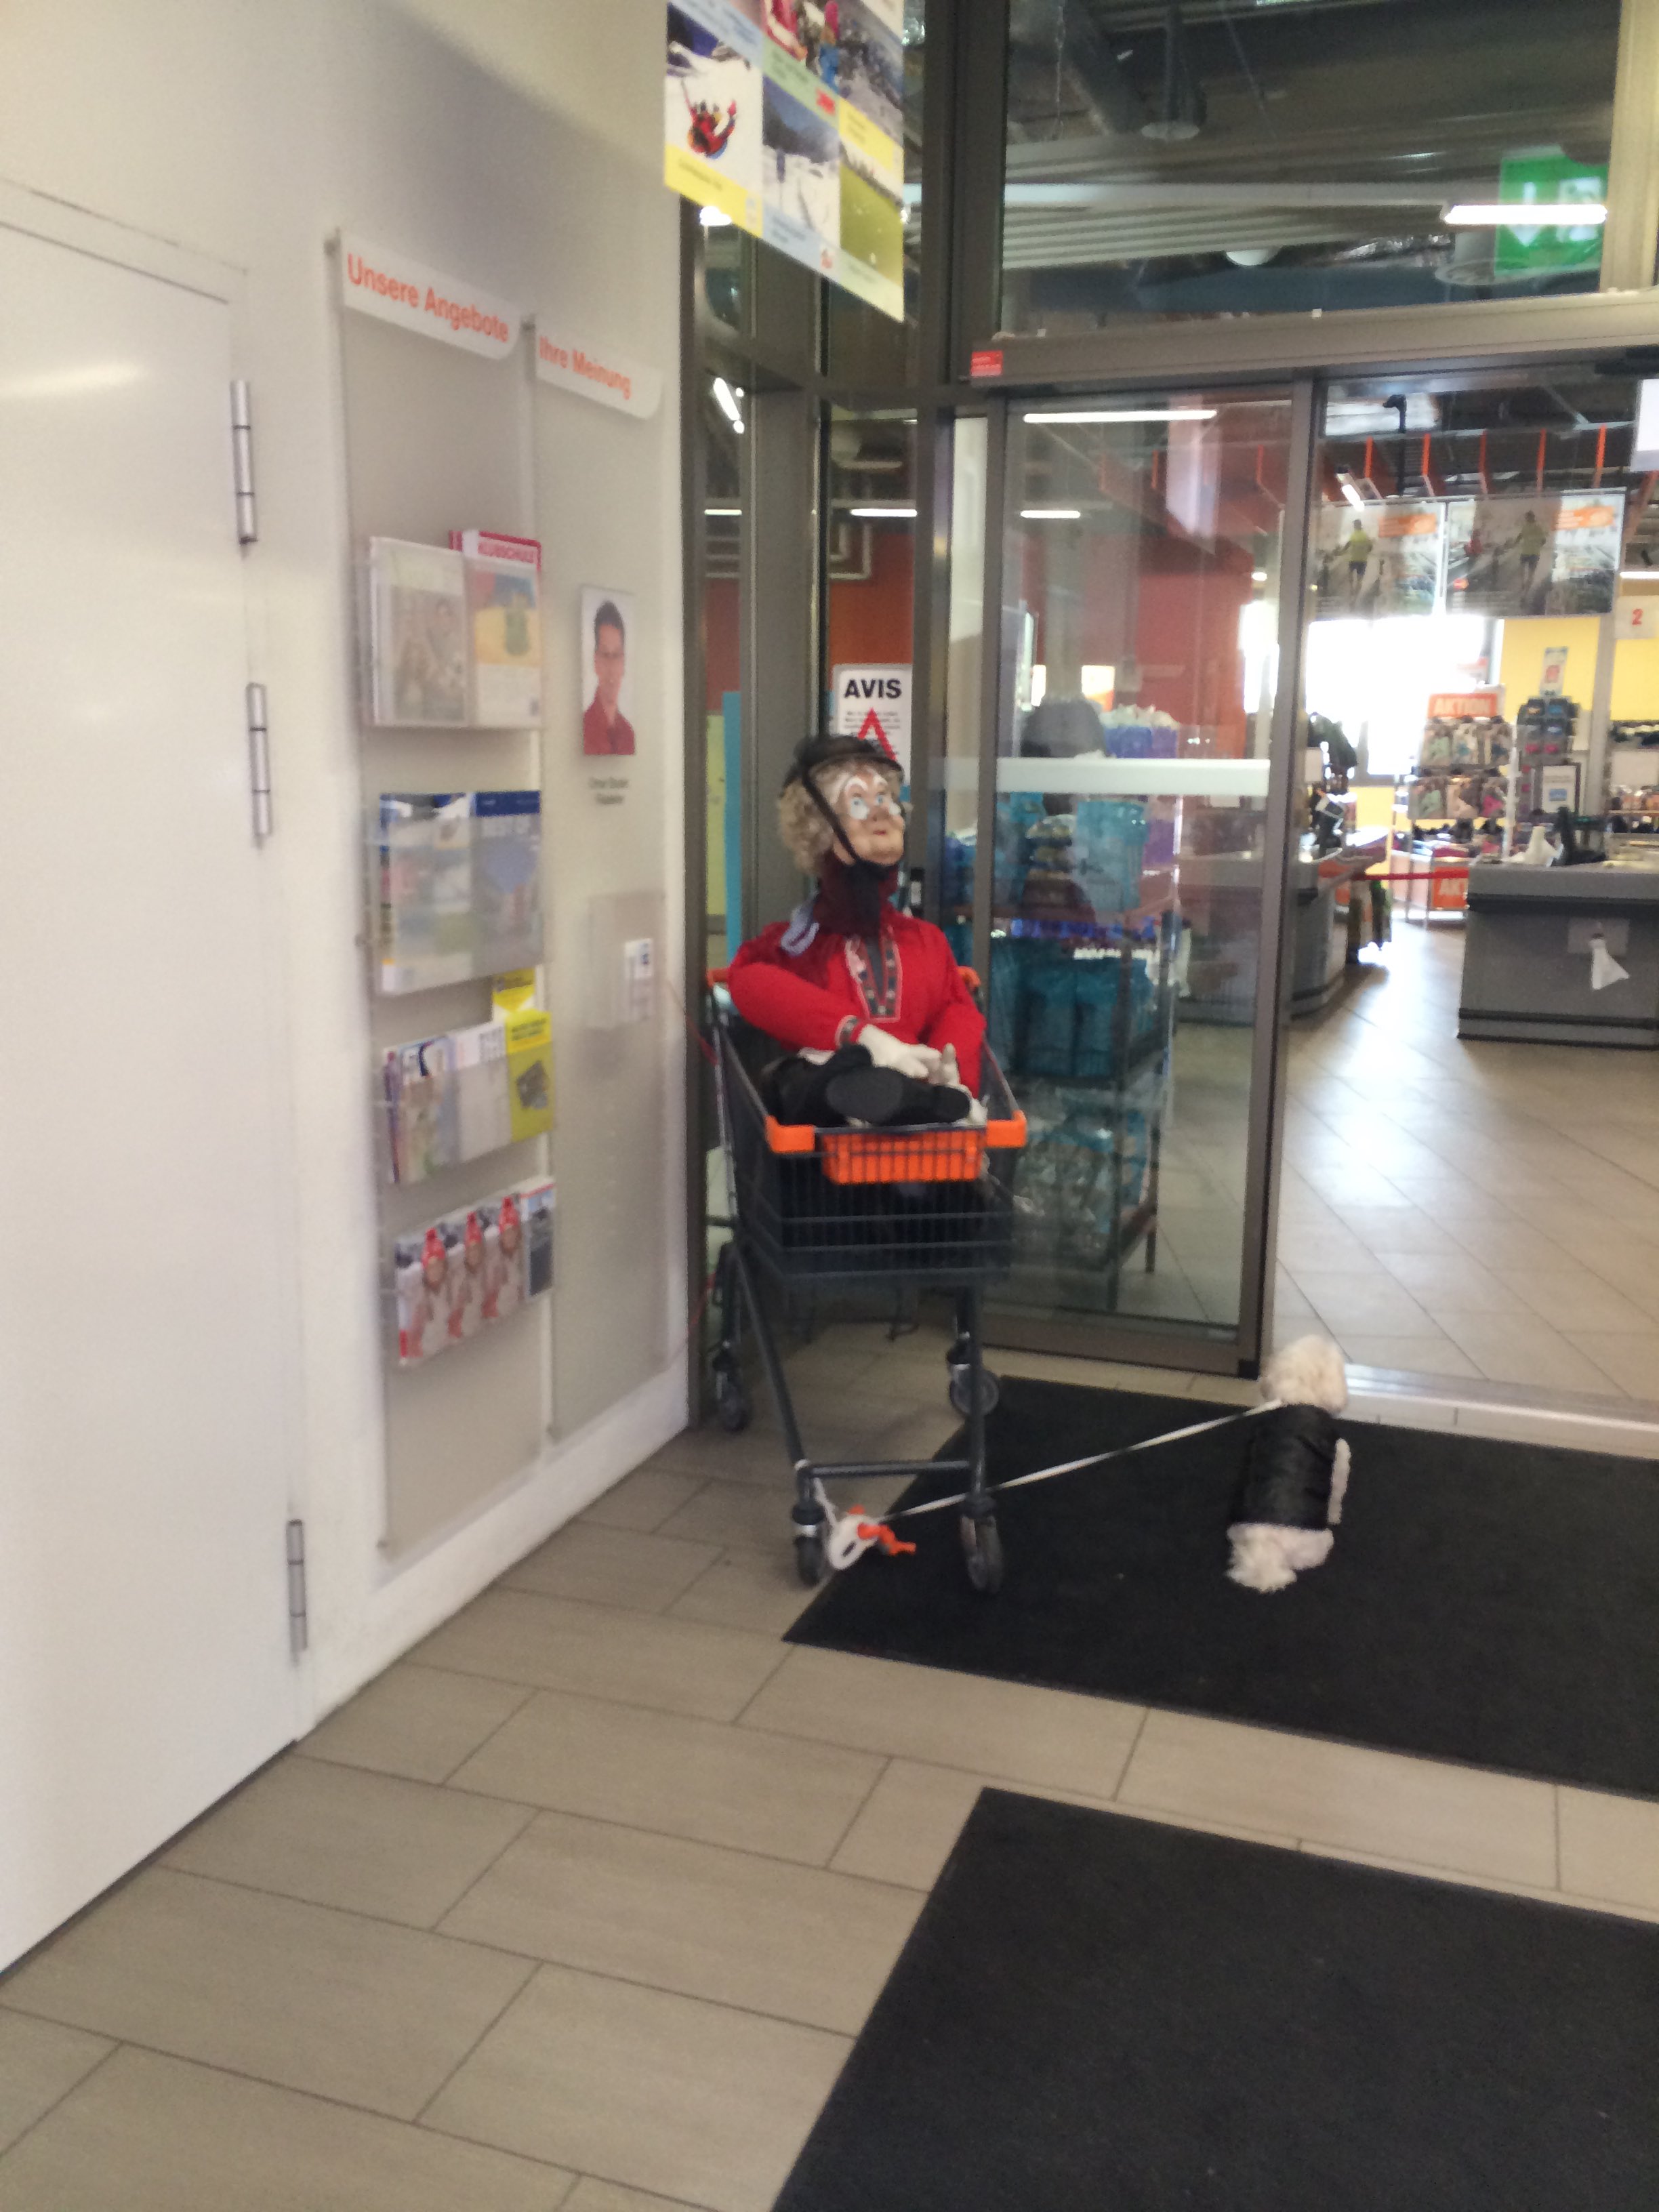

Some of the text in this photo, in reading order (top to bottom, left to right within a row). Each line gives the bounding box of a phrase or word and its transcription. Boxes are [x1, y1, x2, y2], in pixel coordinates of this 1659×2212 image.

[348, 253, 508, 342] Unsere Angebote
[539, 336, 631, 400] Ihre Meinung
[1631, 608, 1643, 626] 2
[844, 678, 902, 699] AVIS
